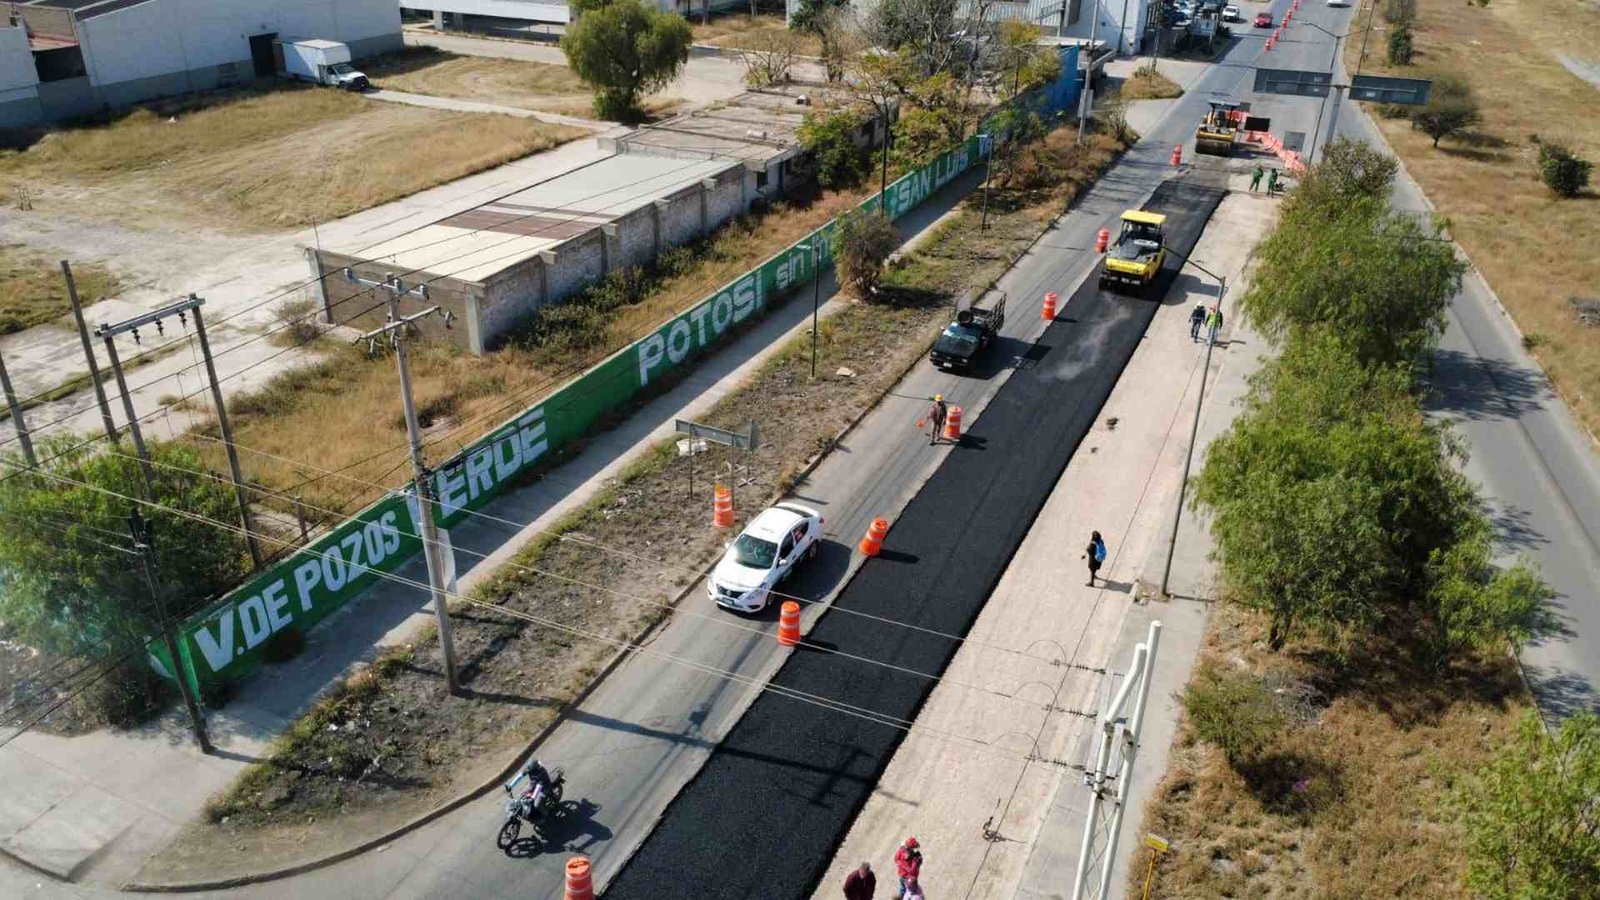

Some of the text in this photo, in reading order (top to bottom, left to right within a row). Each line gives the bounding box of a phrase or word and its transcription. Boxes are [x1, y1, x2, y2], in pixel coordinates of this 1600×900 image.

[935, 151, 968, 188] LUIS
[638, 269, 762, 386] POTOSI
[193, 578, 293, 672] V.DE
[293, 510, 401, 611] POZOS
